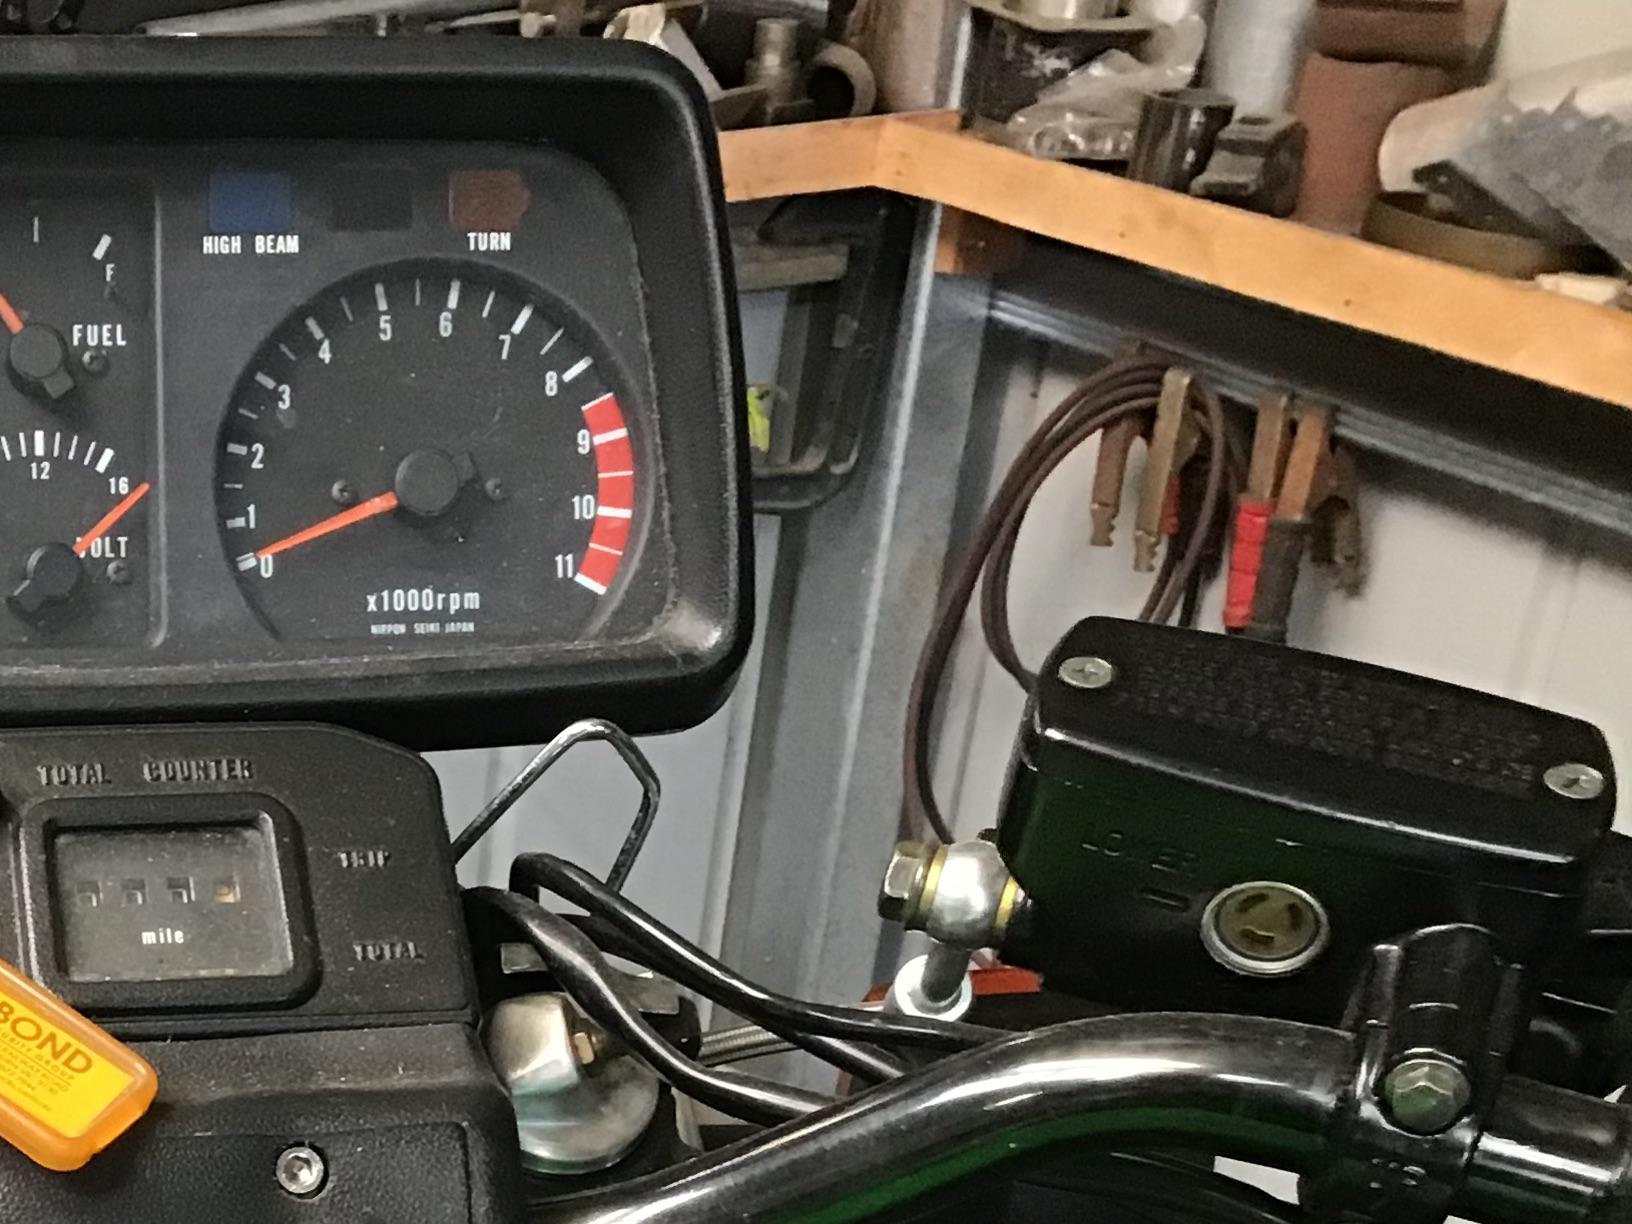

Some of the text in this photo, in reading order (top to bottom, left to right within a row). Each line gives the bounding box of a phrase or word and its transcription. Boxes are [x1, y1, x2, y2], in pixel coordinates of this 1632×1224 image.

[203, 235, 299, 254] HIGH BEAM
[467, 233, 511, 251] TURN
[105, 263, 115, 282] F
[72, 323, 127, 346] FUEL
[379, 316, 391, 340] 5
[439, 312, 452, 337] 6
[318, 340, 331, 363] 4
[498, 335, 512, 359] 7
[545, 371, 558, 396] 8
[278, 385, 291, 409] 3
[577, 430, 590, 454] 9
[251, 445, 264, 468] 2
[31, 462, 50, 480] 12
[109, 477, 129, 495] 16
[247, 505, 255, 528] 1
[572, 497, 594, 519] 10
[260, 555, 273, 578] 0
[555, 554, 573, 578] 11
[36, 759, 252, 786] TOTAL COUNTER
[337, 850, 390, 869] TRIP
[141, 927, 184, 944] mile
[353, 940, 425, 963] TOTAL
